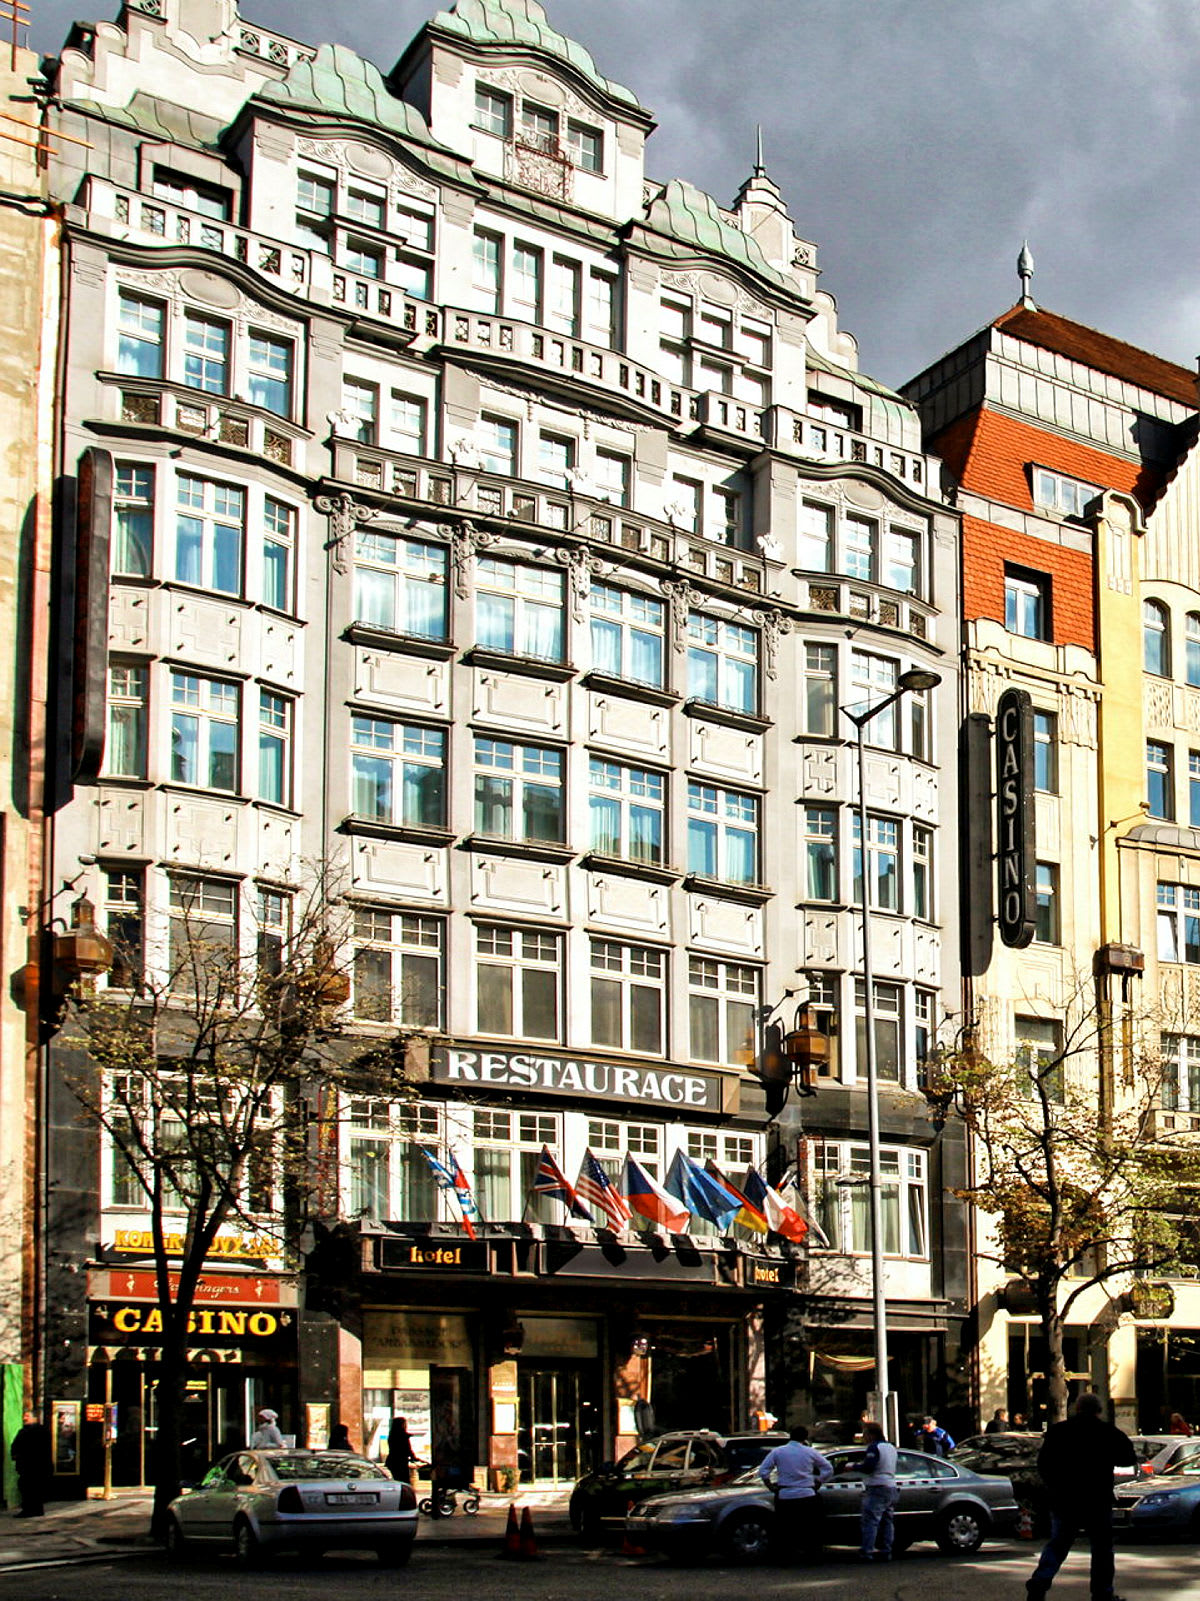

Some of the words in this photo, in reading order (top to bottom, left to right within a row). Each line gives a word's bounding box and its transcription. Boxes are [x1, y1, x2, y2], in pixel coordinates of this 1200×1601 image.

[1002, 707, 1021, 924] CASINO
[448, 1050, 707, 1106] RESTAURACE
[115, 1230, 243, 1251] KONGROVÝ
[410, 1246, 461, 1264] hotel
